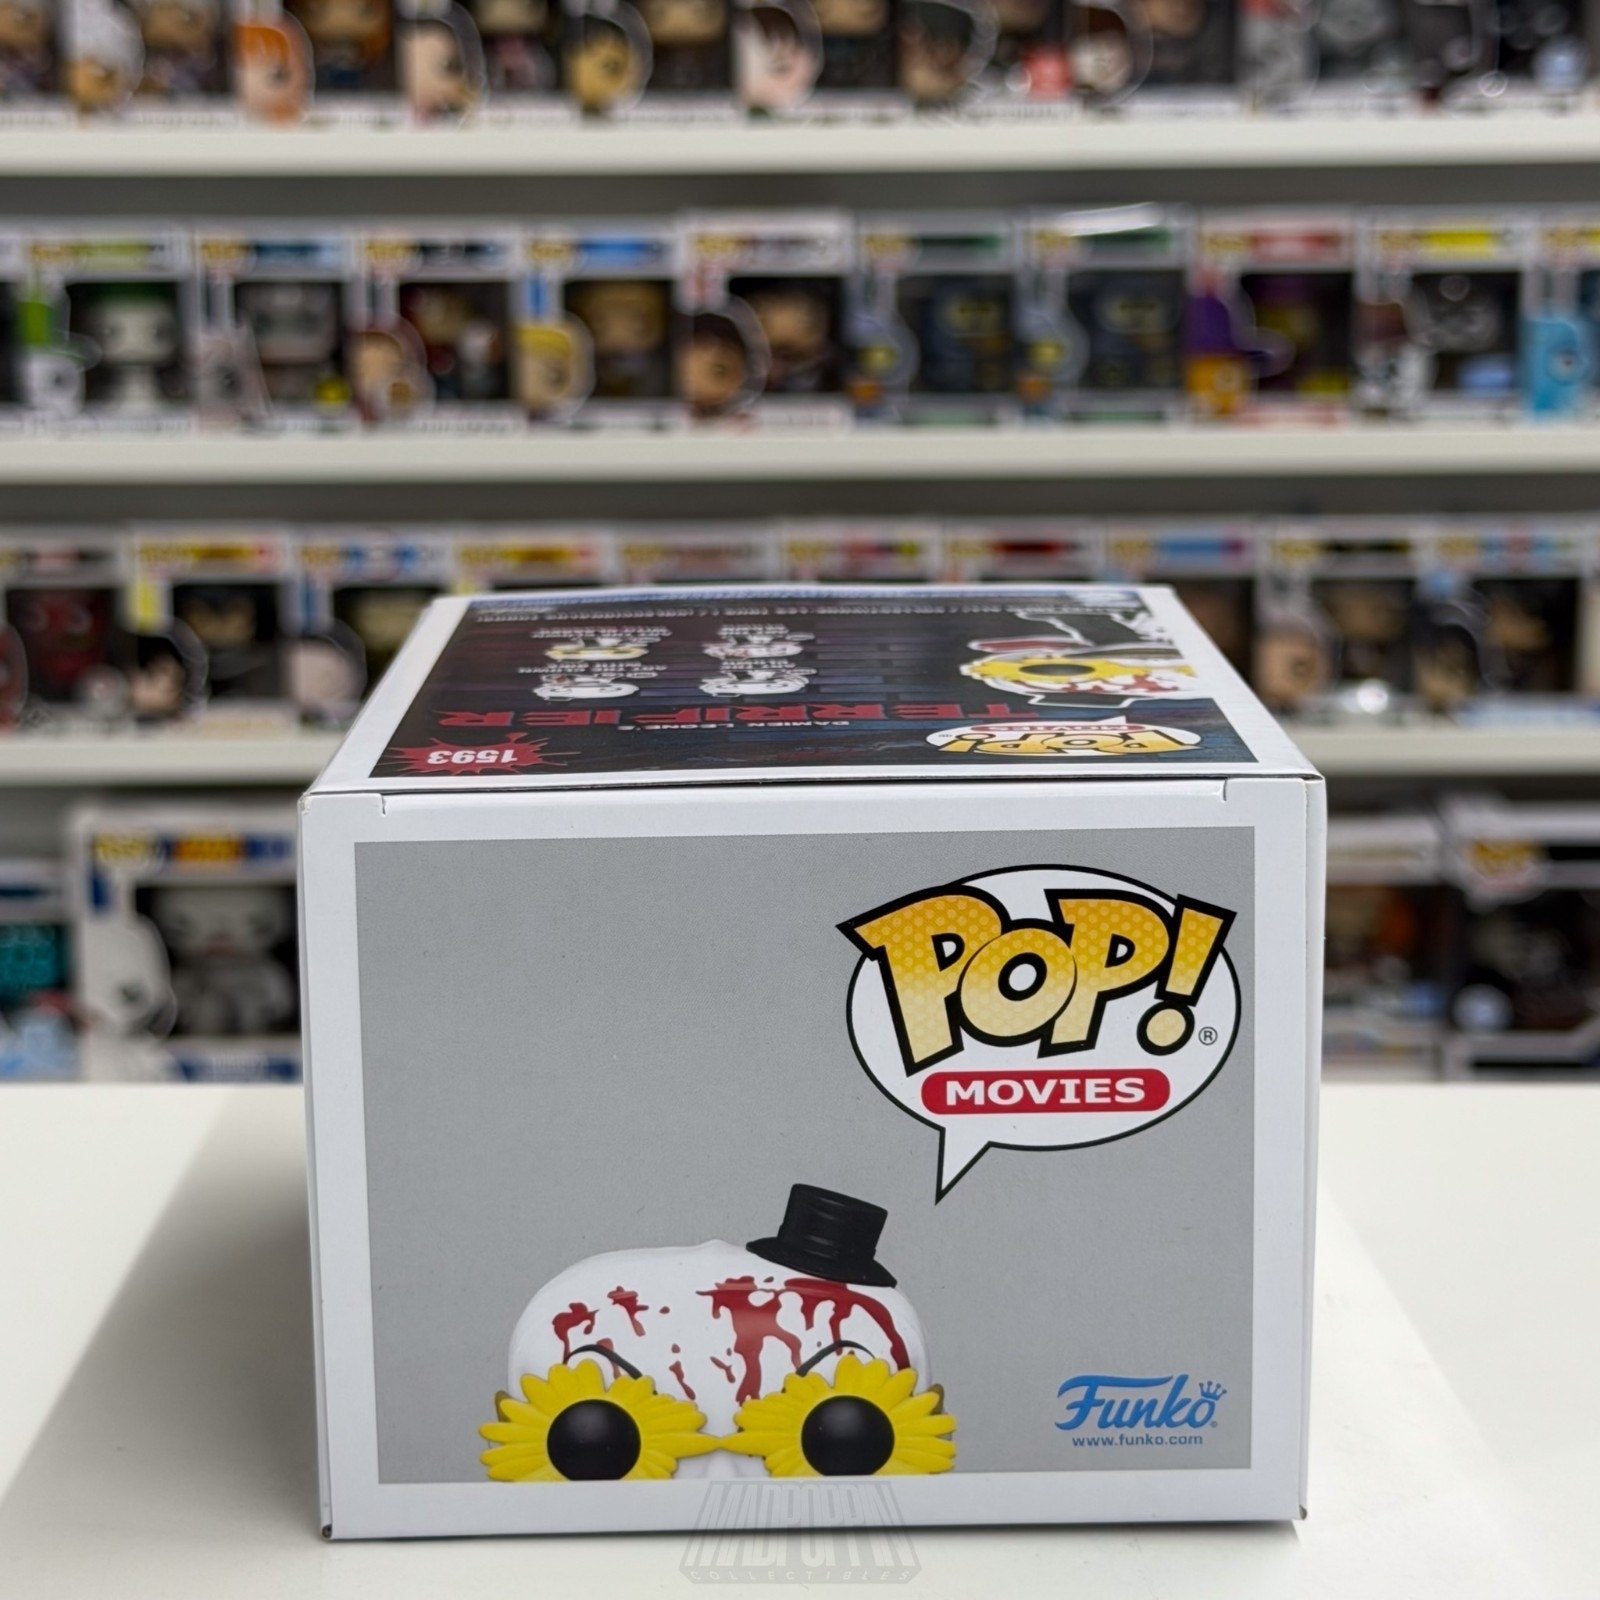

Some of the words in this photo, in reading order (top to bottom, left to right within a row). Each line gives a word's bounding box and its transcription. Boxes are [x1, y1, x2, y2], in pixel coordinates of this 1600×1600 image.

[432, 703, 1038, 727] TERRIFIER
[746, 720, 850, 728] DAMIEN
[990, 724, 1123, 732] MOVIES
[938, 730, 1206, 755] POP!
[426, 749, 518, 764] 1593
[836, 884, 1238, 1077] POP!
[945, 1077, 1146, 1106] MOVIES
[1054, 1374, 1217, 1431] Funko
[1072, 1433, 1204, 1447] www.funko.com
